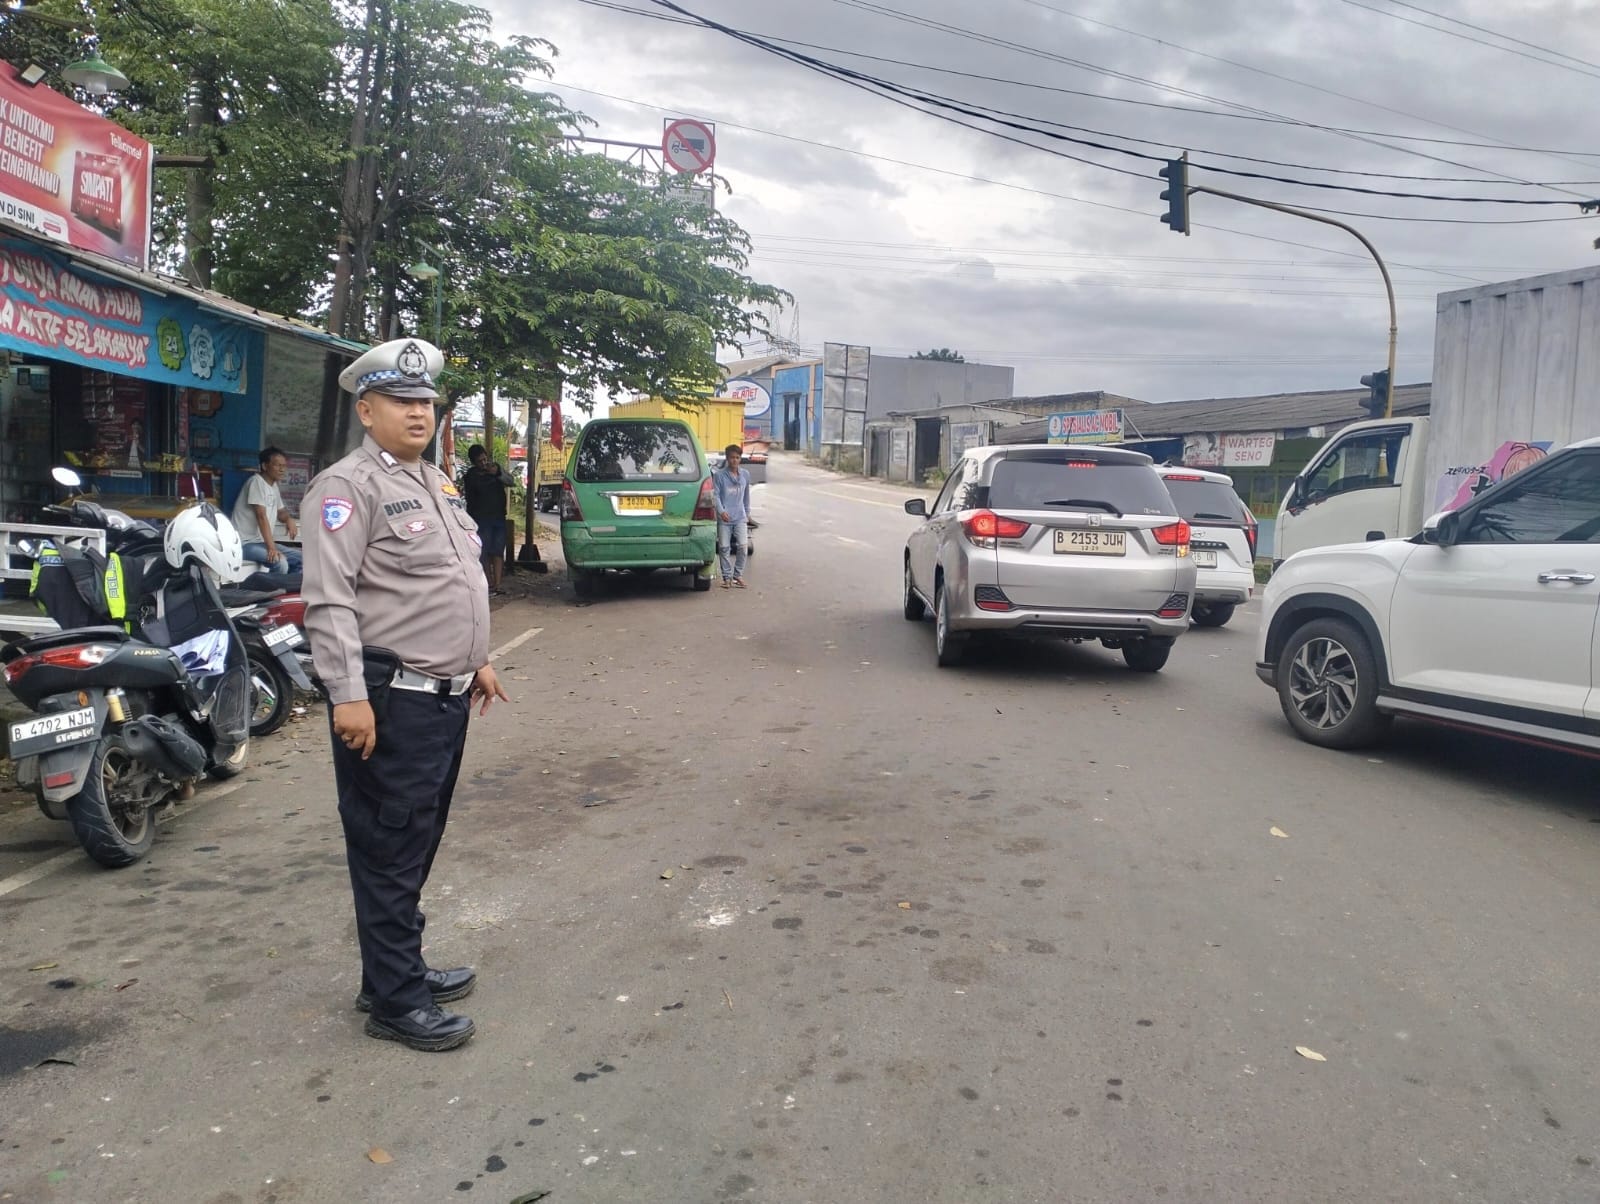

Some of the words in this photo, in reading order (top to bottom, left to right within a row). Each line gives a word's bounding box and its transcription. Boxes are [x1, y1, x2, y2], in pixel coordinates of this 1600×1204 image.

[9, 103, 55, 145] UNTUKMU
[4, 126, 43, 162] BENEFIT
[0, 148, 61, 195] EINGINANMU
[7, 204, 17, 217] DI
[18, 208, 35, 224] SINI
[102, 288, 142, 322] MUDA
[1228, 437, 1273, 449] WARTEG
[1234, 451, 1263, 461] SENO
[1057, 531, 1064, 543] B
[1071, 532, 1099, 545] 2153
[1103, 533, 1124, 546] JUW
[14, 727, 22, 740] B
[67, 710, 94, 728] NJM
